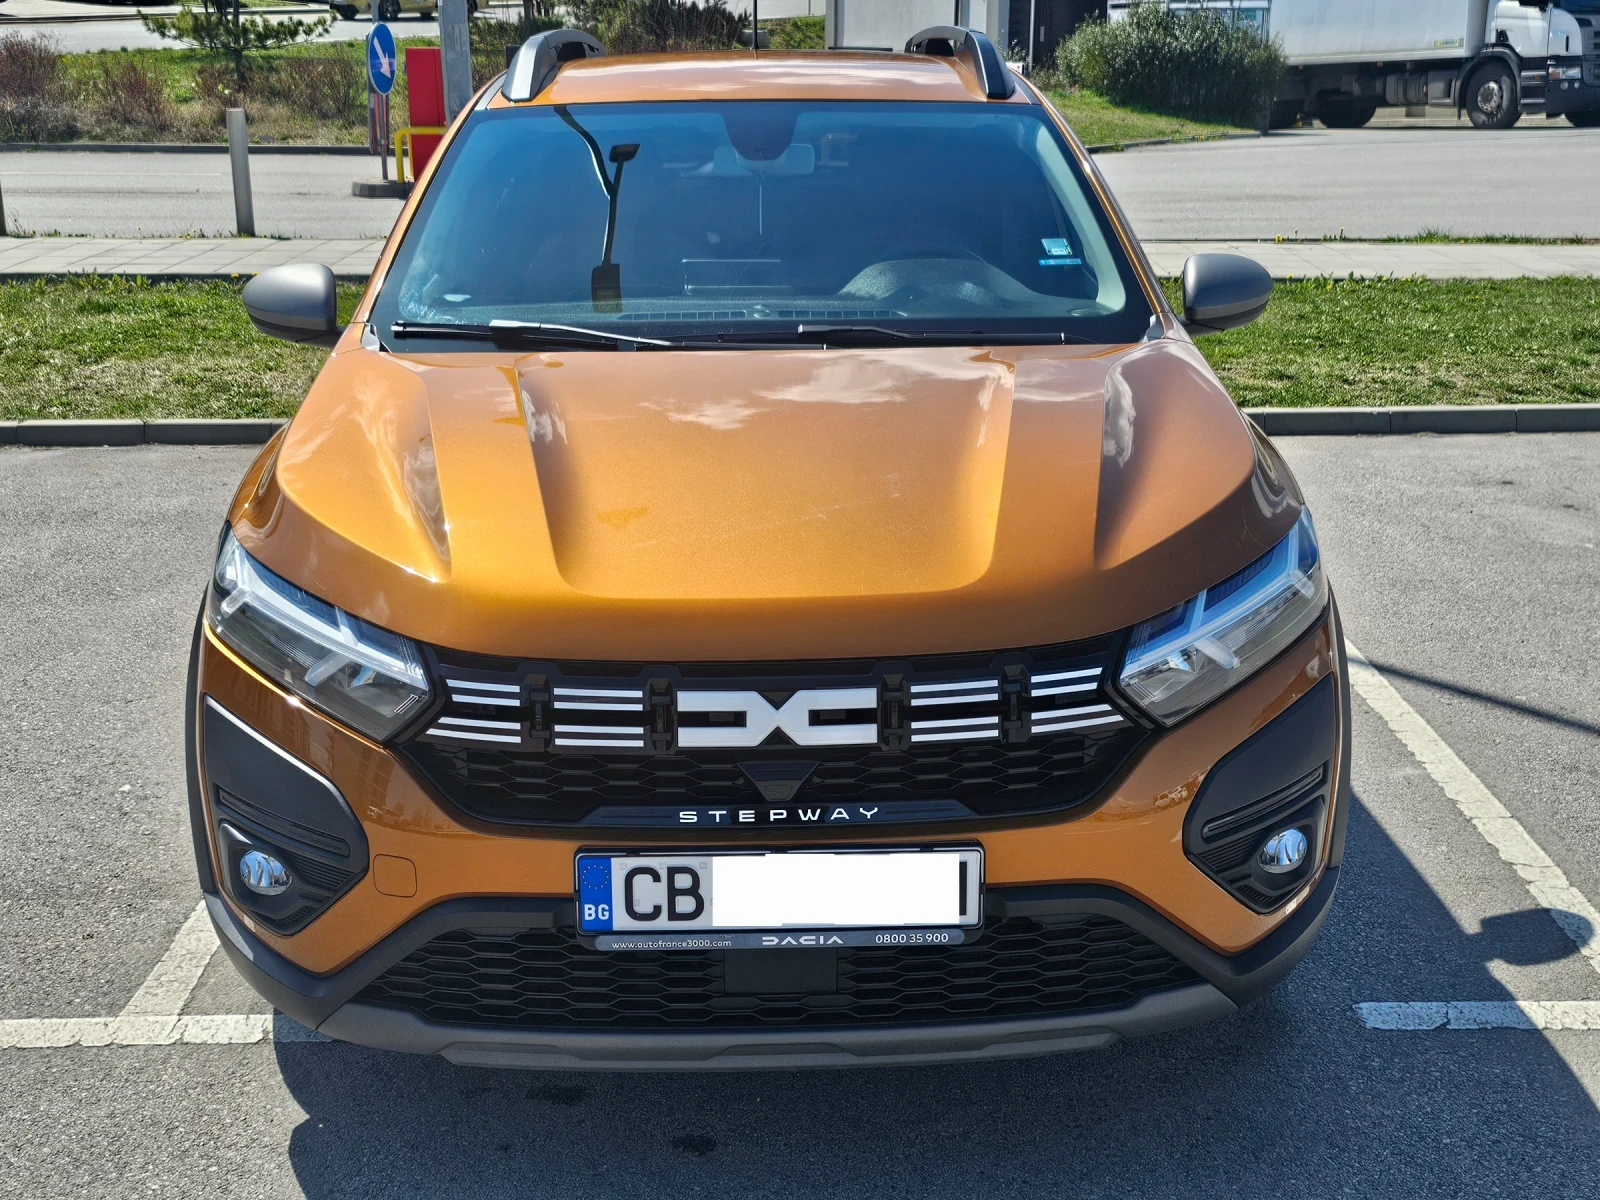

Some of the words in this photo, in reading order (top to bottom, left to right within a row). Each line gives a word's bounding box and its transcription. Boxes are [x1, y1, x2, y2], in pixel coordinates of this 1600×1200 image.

[679, 807, 879, 823] STEPWAY
[624, 866, 705, 922] CB
[584, 904, 609, 920] BG
[612, 939, 732, 949] www.autofrance3000.com
[762, 935, 844, 945] DACIA
[875, 934, 907, 944] 0800
[909, 933, 923, 943] 35
[925, 933, 949, 943] 900
